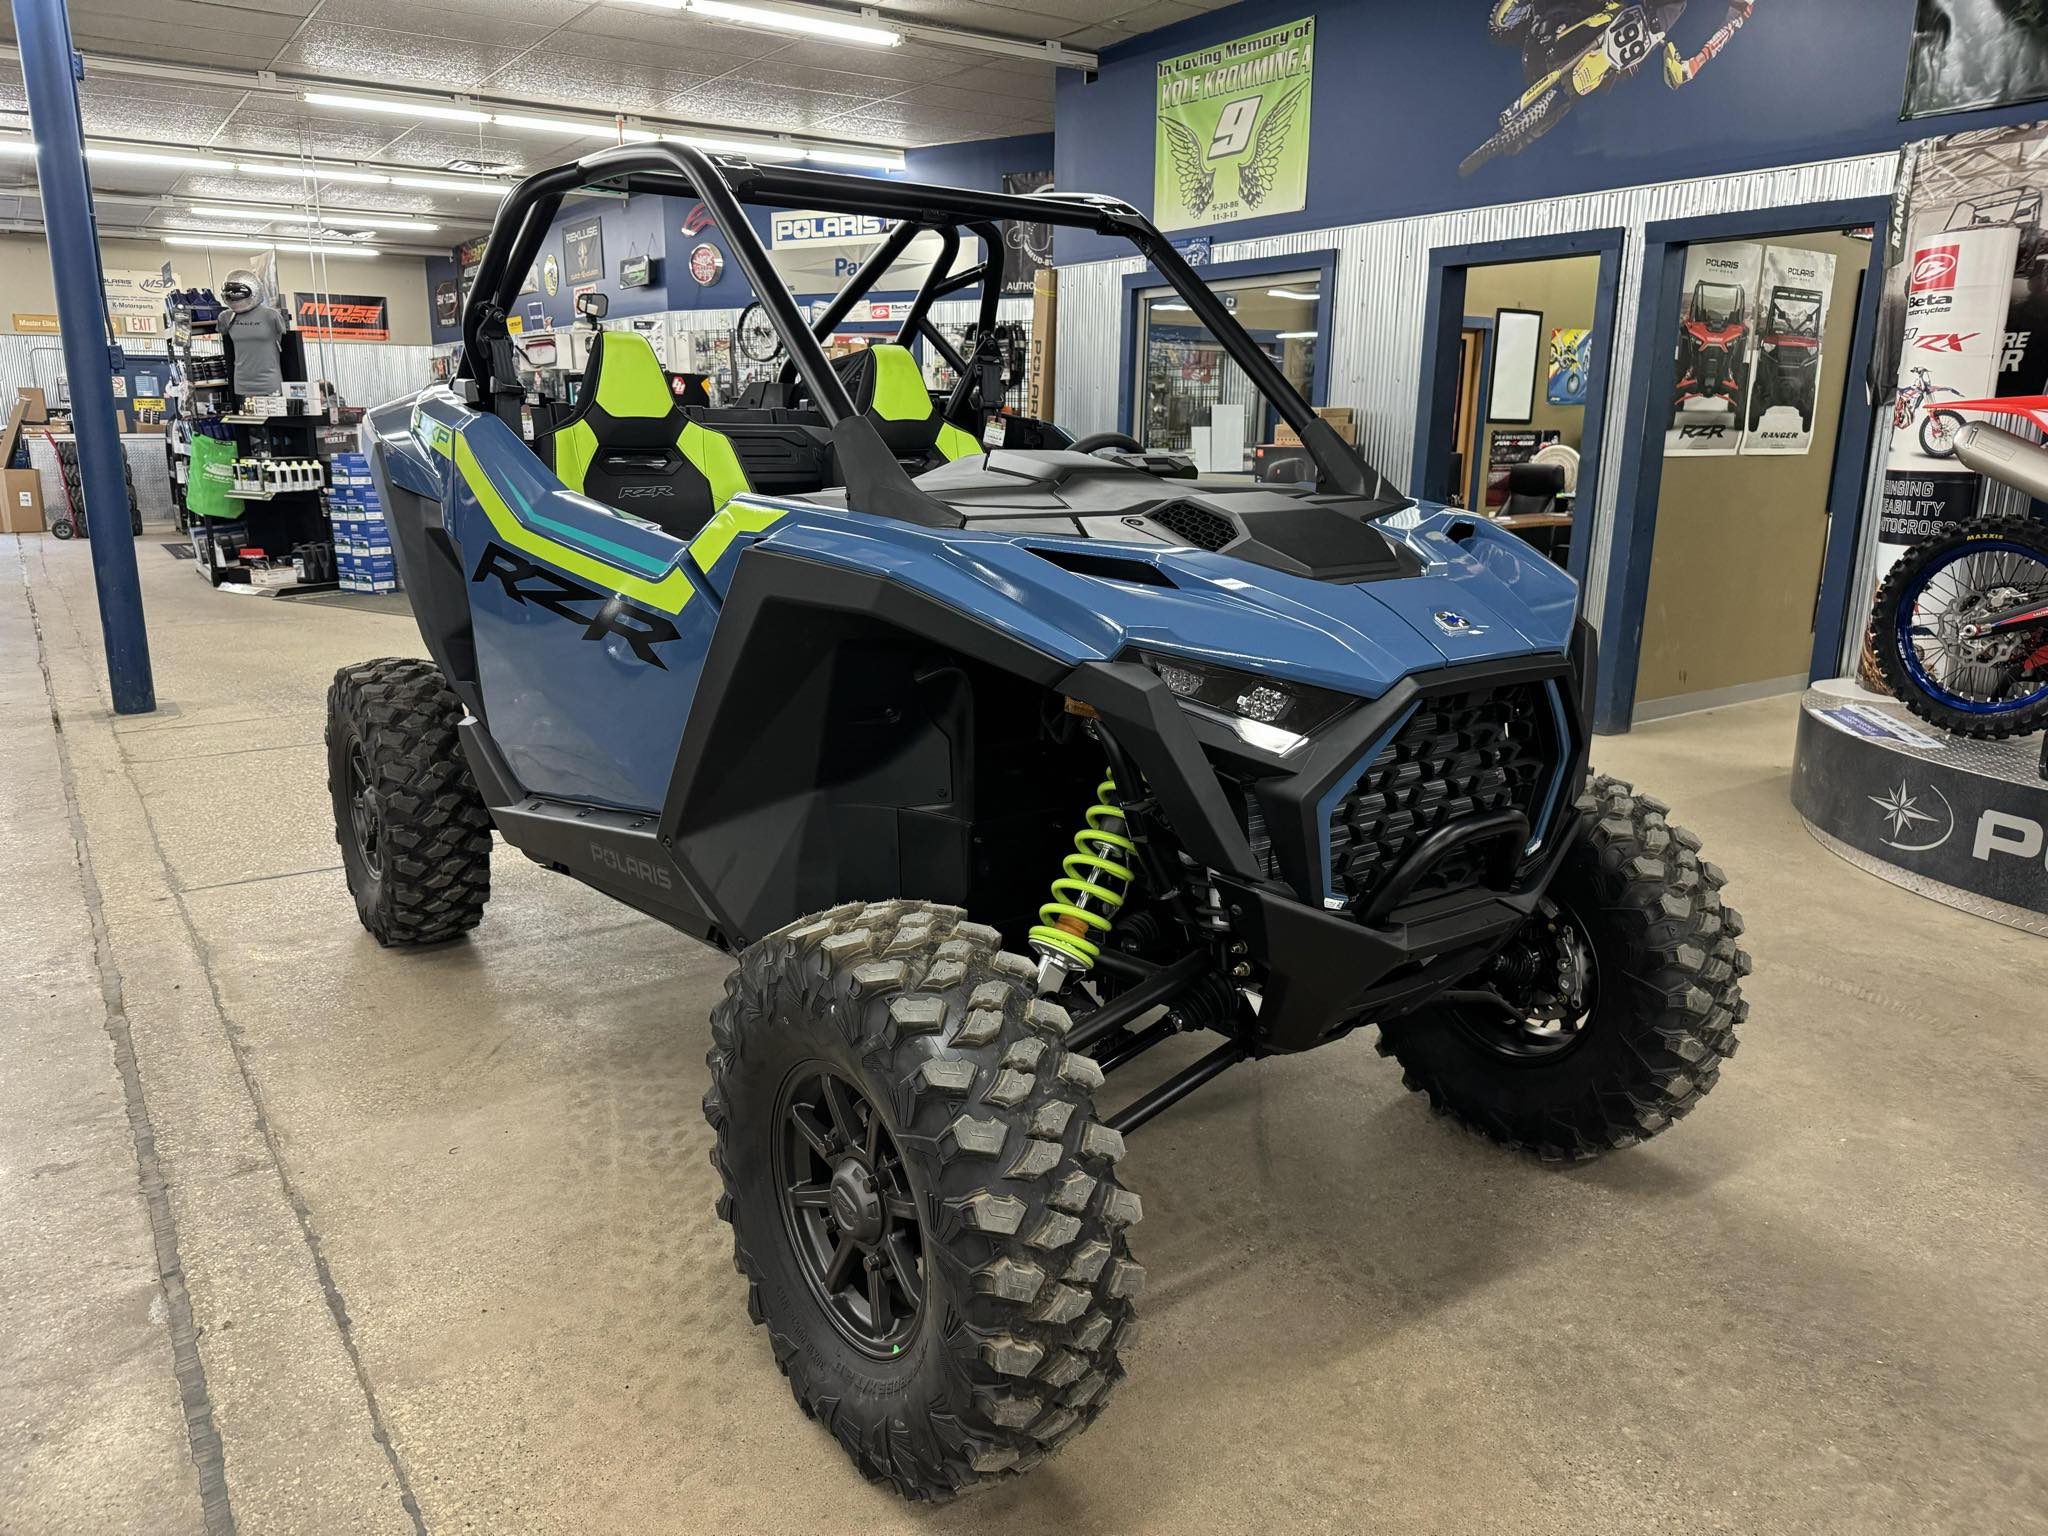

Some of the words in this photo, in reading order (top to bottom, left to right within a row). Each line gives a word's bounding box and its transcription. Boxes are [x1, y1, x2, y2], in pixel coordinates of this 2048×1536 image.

[1158, 63, 1171, 77] In
[1176, 49, 1221, 73] Loving
[1225, 31, 1289, 59] Memory
[1294, 20, 1312, 38] of
[1160, 75, 1200, 110] KOLE
[1207, 94, 1263, 161] 9
[776, 215, 880, 241] POLARIS
[1705, 258, 1739, 269] POLARIS
[1787, 267, 1815, 277] POLARIS
[112, 302, 153, 310] K-Motorsports
[1909, 294, 1952, 308] Beta
[299, 302, 384, 317] MOOSE
[132, 317, 151, 331] EXIT
[1679, 424, 1728, 440] RZR
[1760, 431, 1798, 439] RANGER
[618, 485, 677, 499] RZR
[1966, 533, 2004, 541] MAXXIS
[472, 541, 682, 672] RZR
[590, 842, 672, 890] POLARIS
